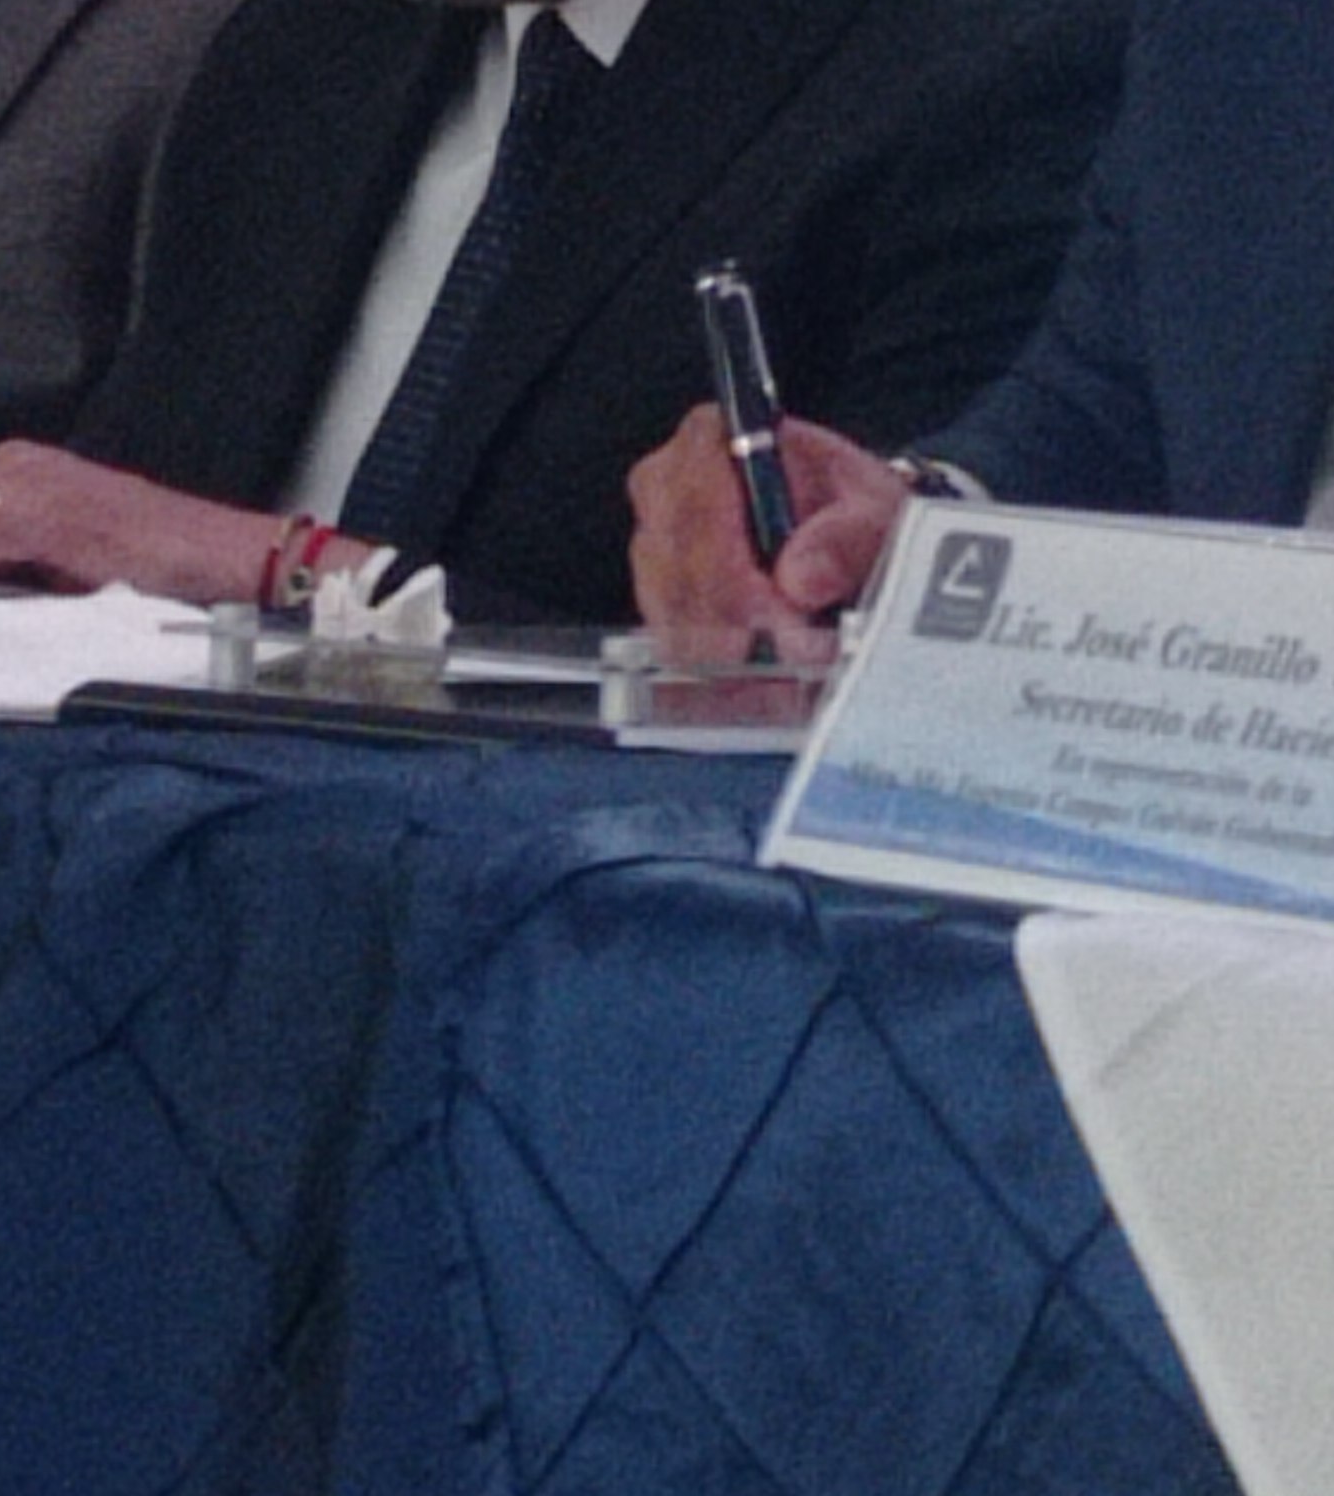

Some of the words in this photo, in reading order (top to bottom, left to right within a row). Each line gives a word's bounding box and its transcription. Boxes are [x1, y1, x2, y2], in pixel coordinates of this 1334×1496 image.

[1062, 613, 1149, 662] José
[1160, 622, 1321, 686] Granillo
[1191, 702, 1233, 744] de
